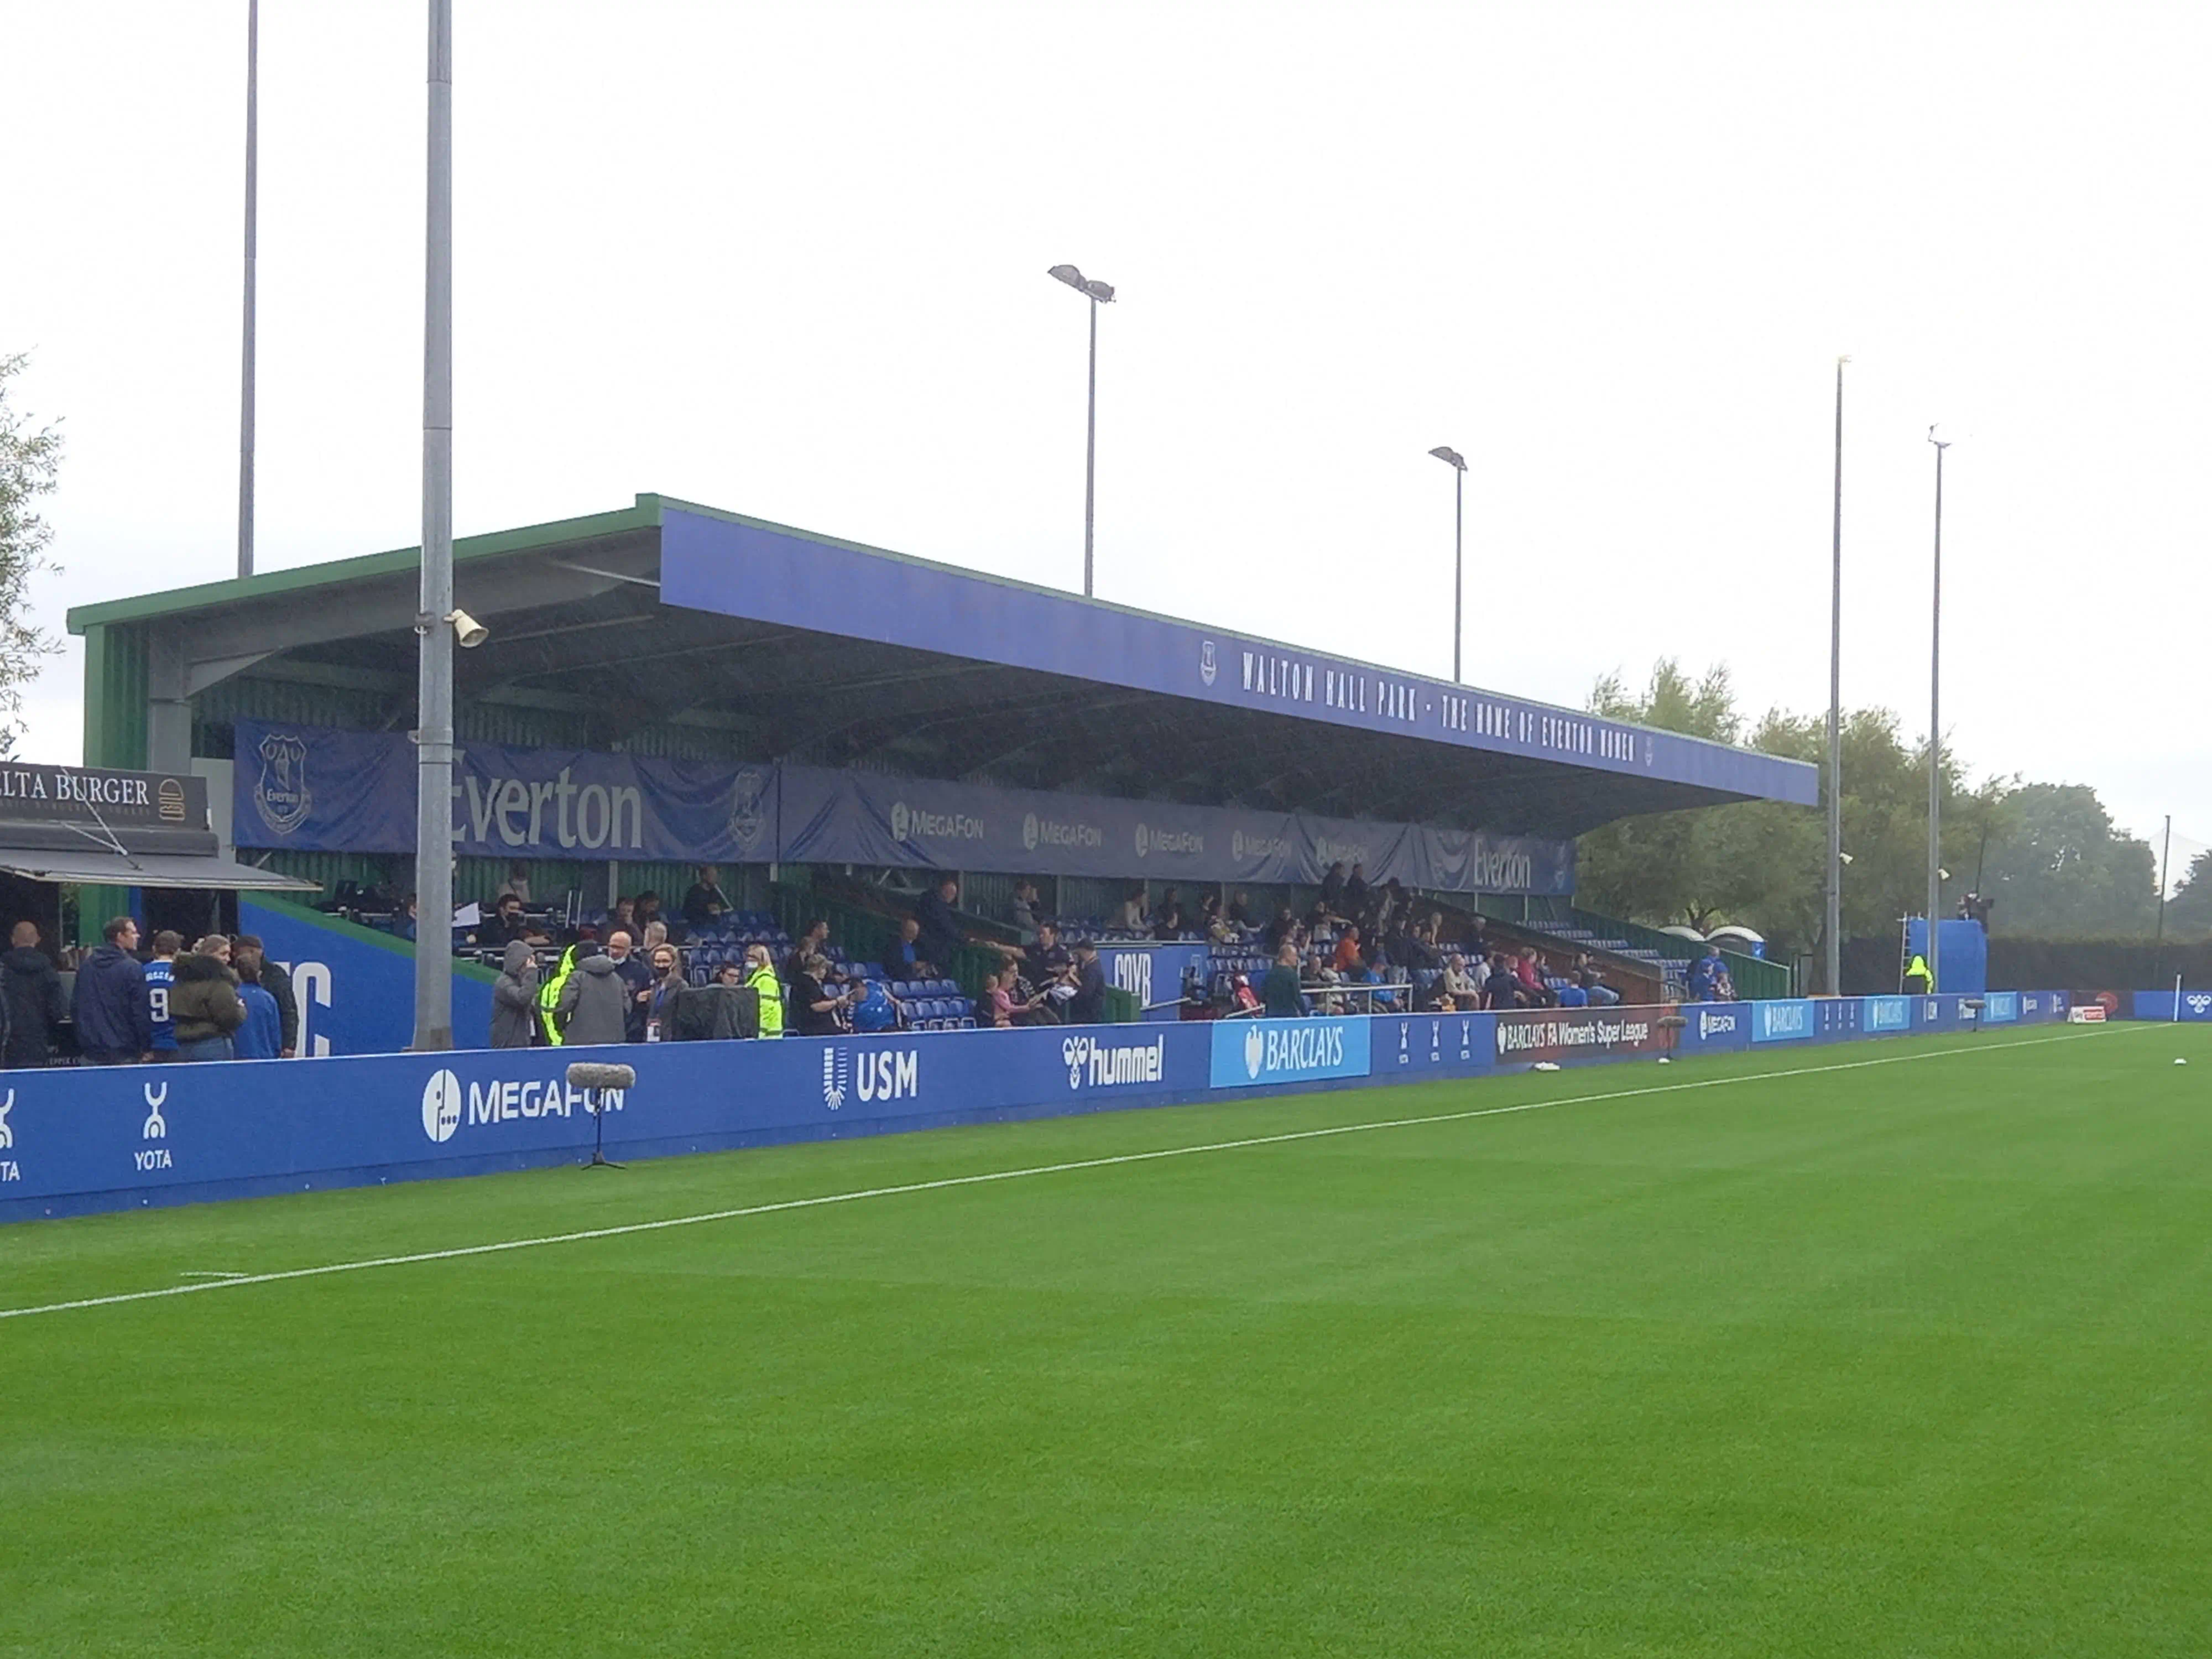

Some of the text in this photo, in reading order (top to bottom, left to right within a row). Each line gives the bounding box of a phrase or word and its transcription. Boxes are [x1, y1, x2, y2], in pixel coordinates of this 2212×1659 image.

[1243, 652, 1634, 762] WALTON HALL PARK THE HOME OF EVERTON WOMEN
[0, 770, 150, 805] LTA BURGER
[1474, 835, 1531, 889] Everton
[149, 988, 169, 1022] 9
[1266, 1026, 1344, 1071] BARCLAYS
[1558, 1021, 1595, 1046] Women's
[1597, 1020, 1620, 1049] Super
[1621, 1019, 1648, 1047] League
[858, 1051, 917, 1102] USM
[1088, 1034, 1164, 1087] hummel
[134, 1150, 173, 1171] YOTA
